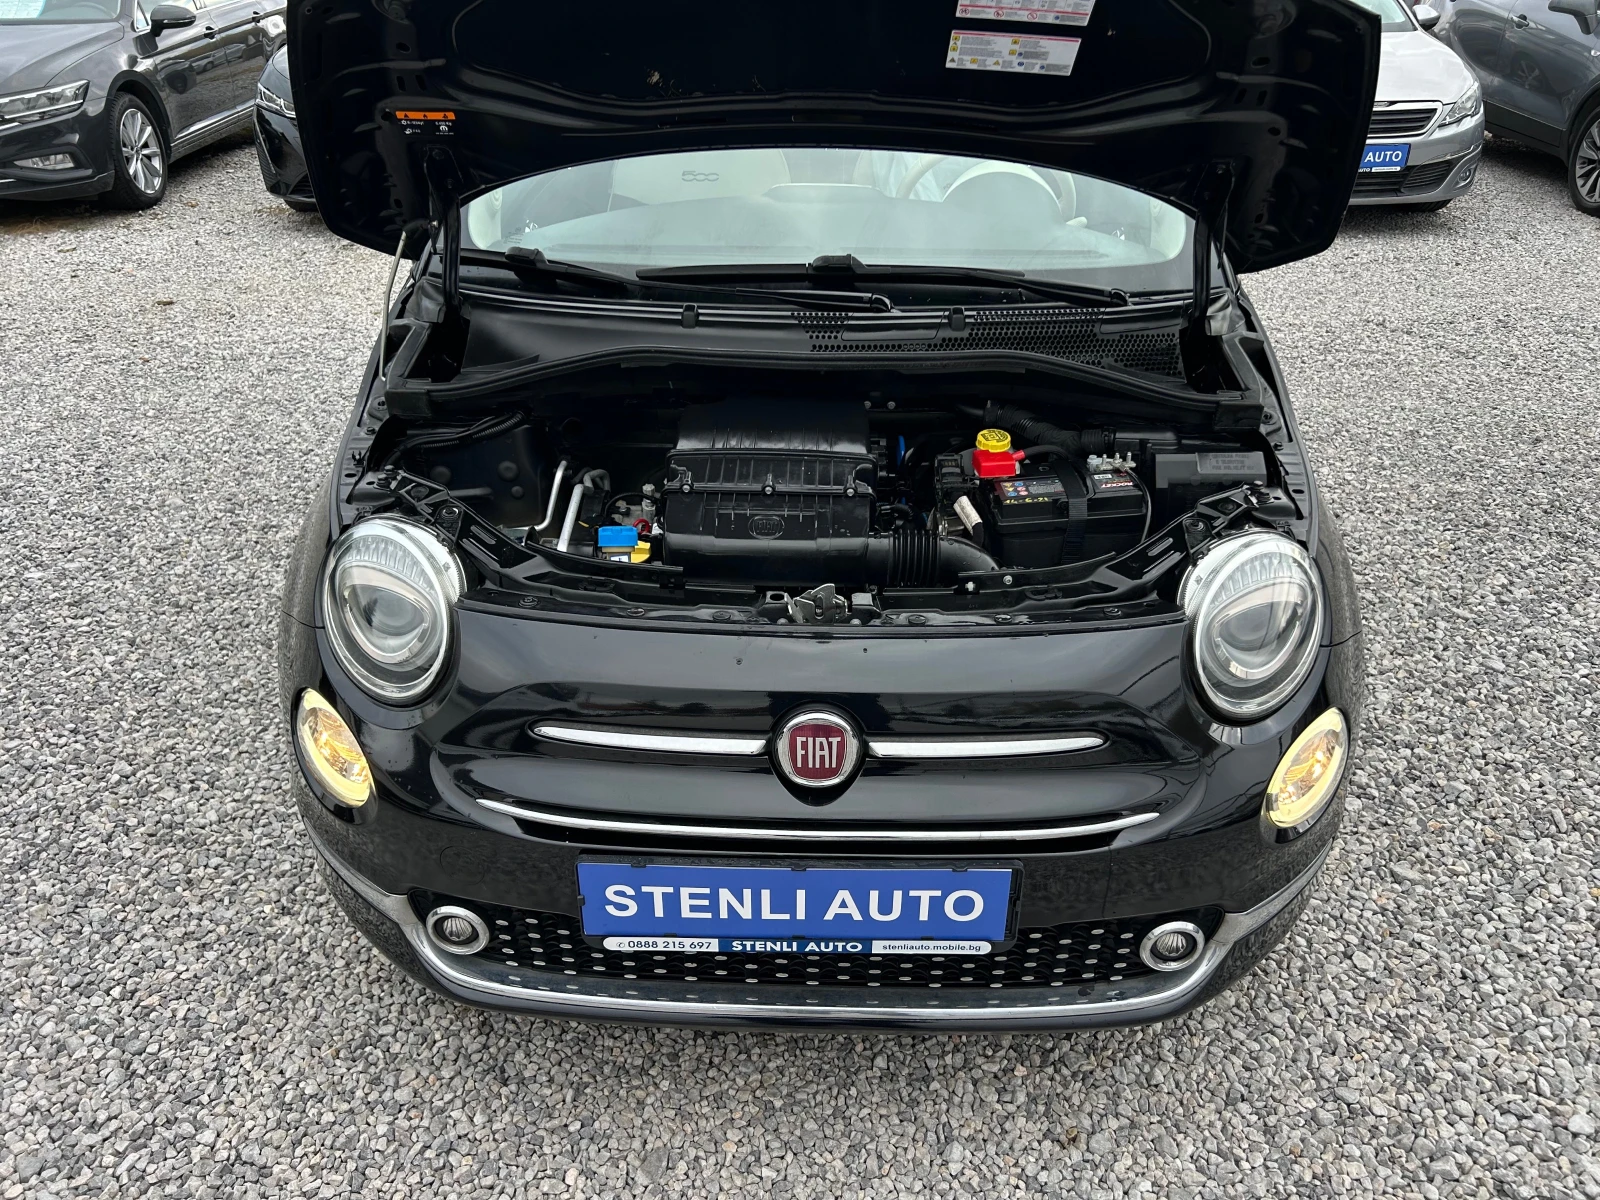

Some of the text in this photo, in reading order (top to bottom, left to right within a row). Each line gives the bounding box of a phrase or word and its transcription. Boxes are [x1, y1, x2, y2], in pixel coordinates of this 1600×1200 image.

[1363, 150, 1402, 163] AUTO
[681, 170, 720, 183] 500
[796, 736, 842, 769] FIAT
[603, 884, 985, 922] STENLI AUTO
[627, 940, 712, 950] 0888 215 697
[731, 940, 863, 952] STENLI AUTO
[882, 942, 982, 953] stenliauto.mobile.bg
